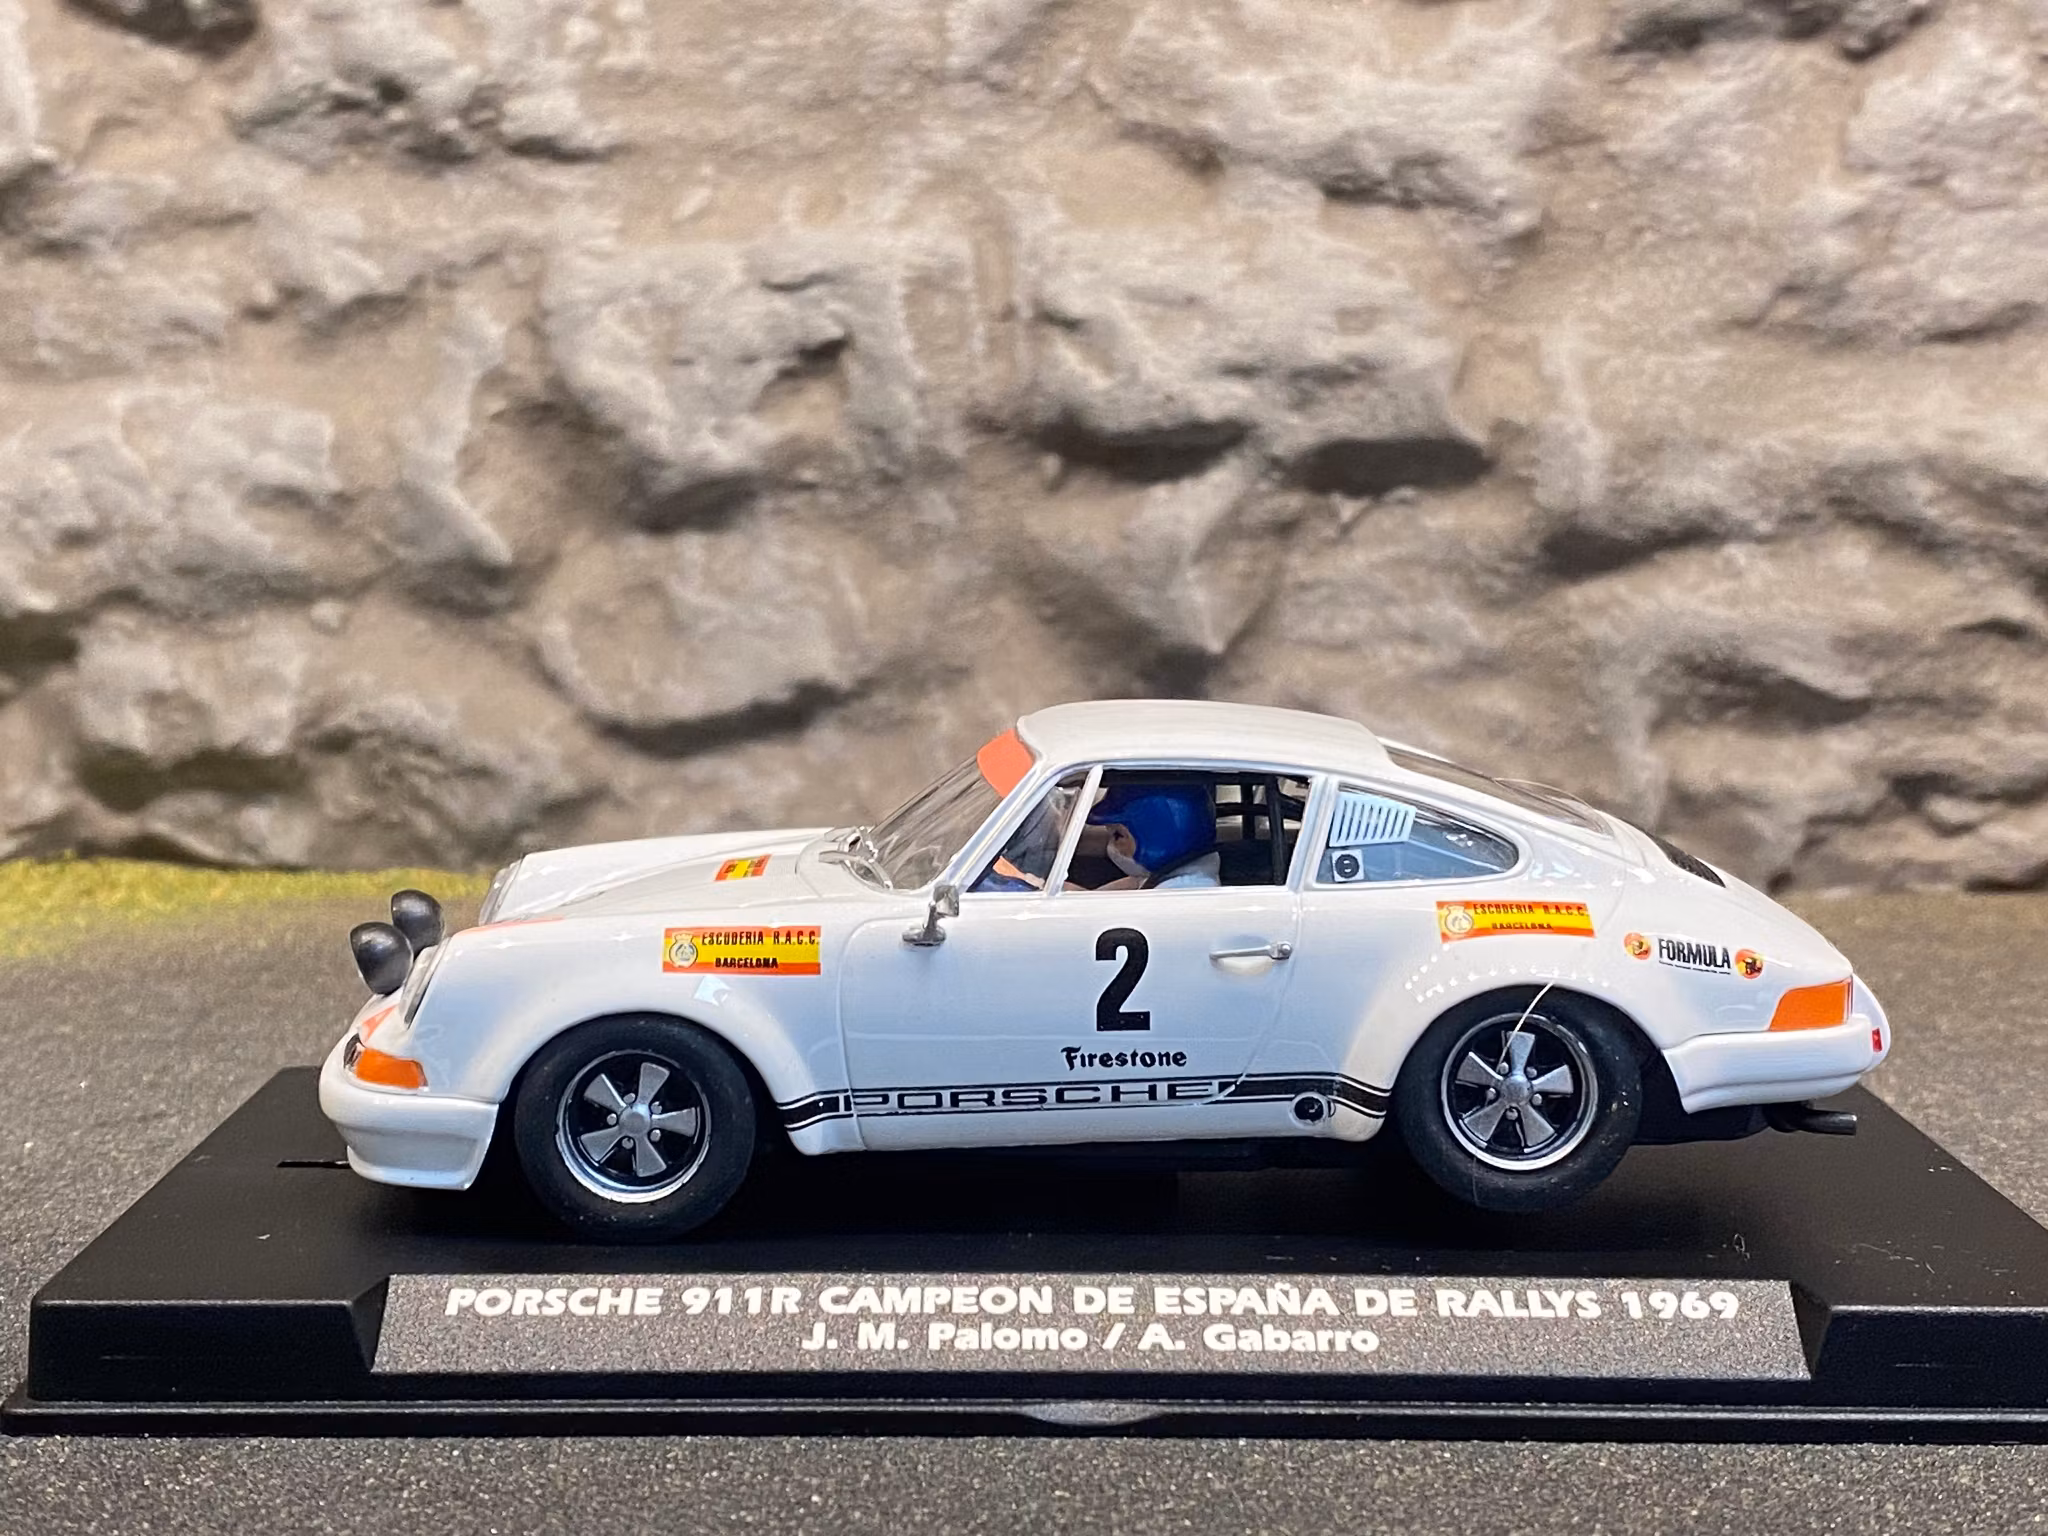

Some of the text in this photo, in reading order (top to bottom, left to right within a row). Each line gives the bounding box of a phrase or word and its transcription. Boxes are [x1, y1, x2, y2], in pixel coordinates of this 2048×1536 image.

[1472, 903, 1535, 915] ESCUDERIA
[701, 931, 764, 946] ESCUDERIA
[1491, 922, 1553, 931] BARCELONA
[715, 957, 779, 969] BARCELONA
[1658, 938, 1731, 969] FORMULA
[1095, 927, 1151, 1032] 2
[1060, 1046, 1188, 1071] Firestone
[843, 1081, 1212, 1112] PORSCHE
[445, 1282, 1739, 1320] PORSCHE 911R CAMPEON DE ESPAÑA DE RALLYS 1969
[801, 1322, 1380, 1352] J. M. Palomo / A. Gabarro
